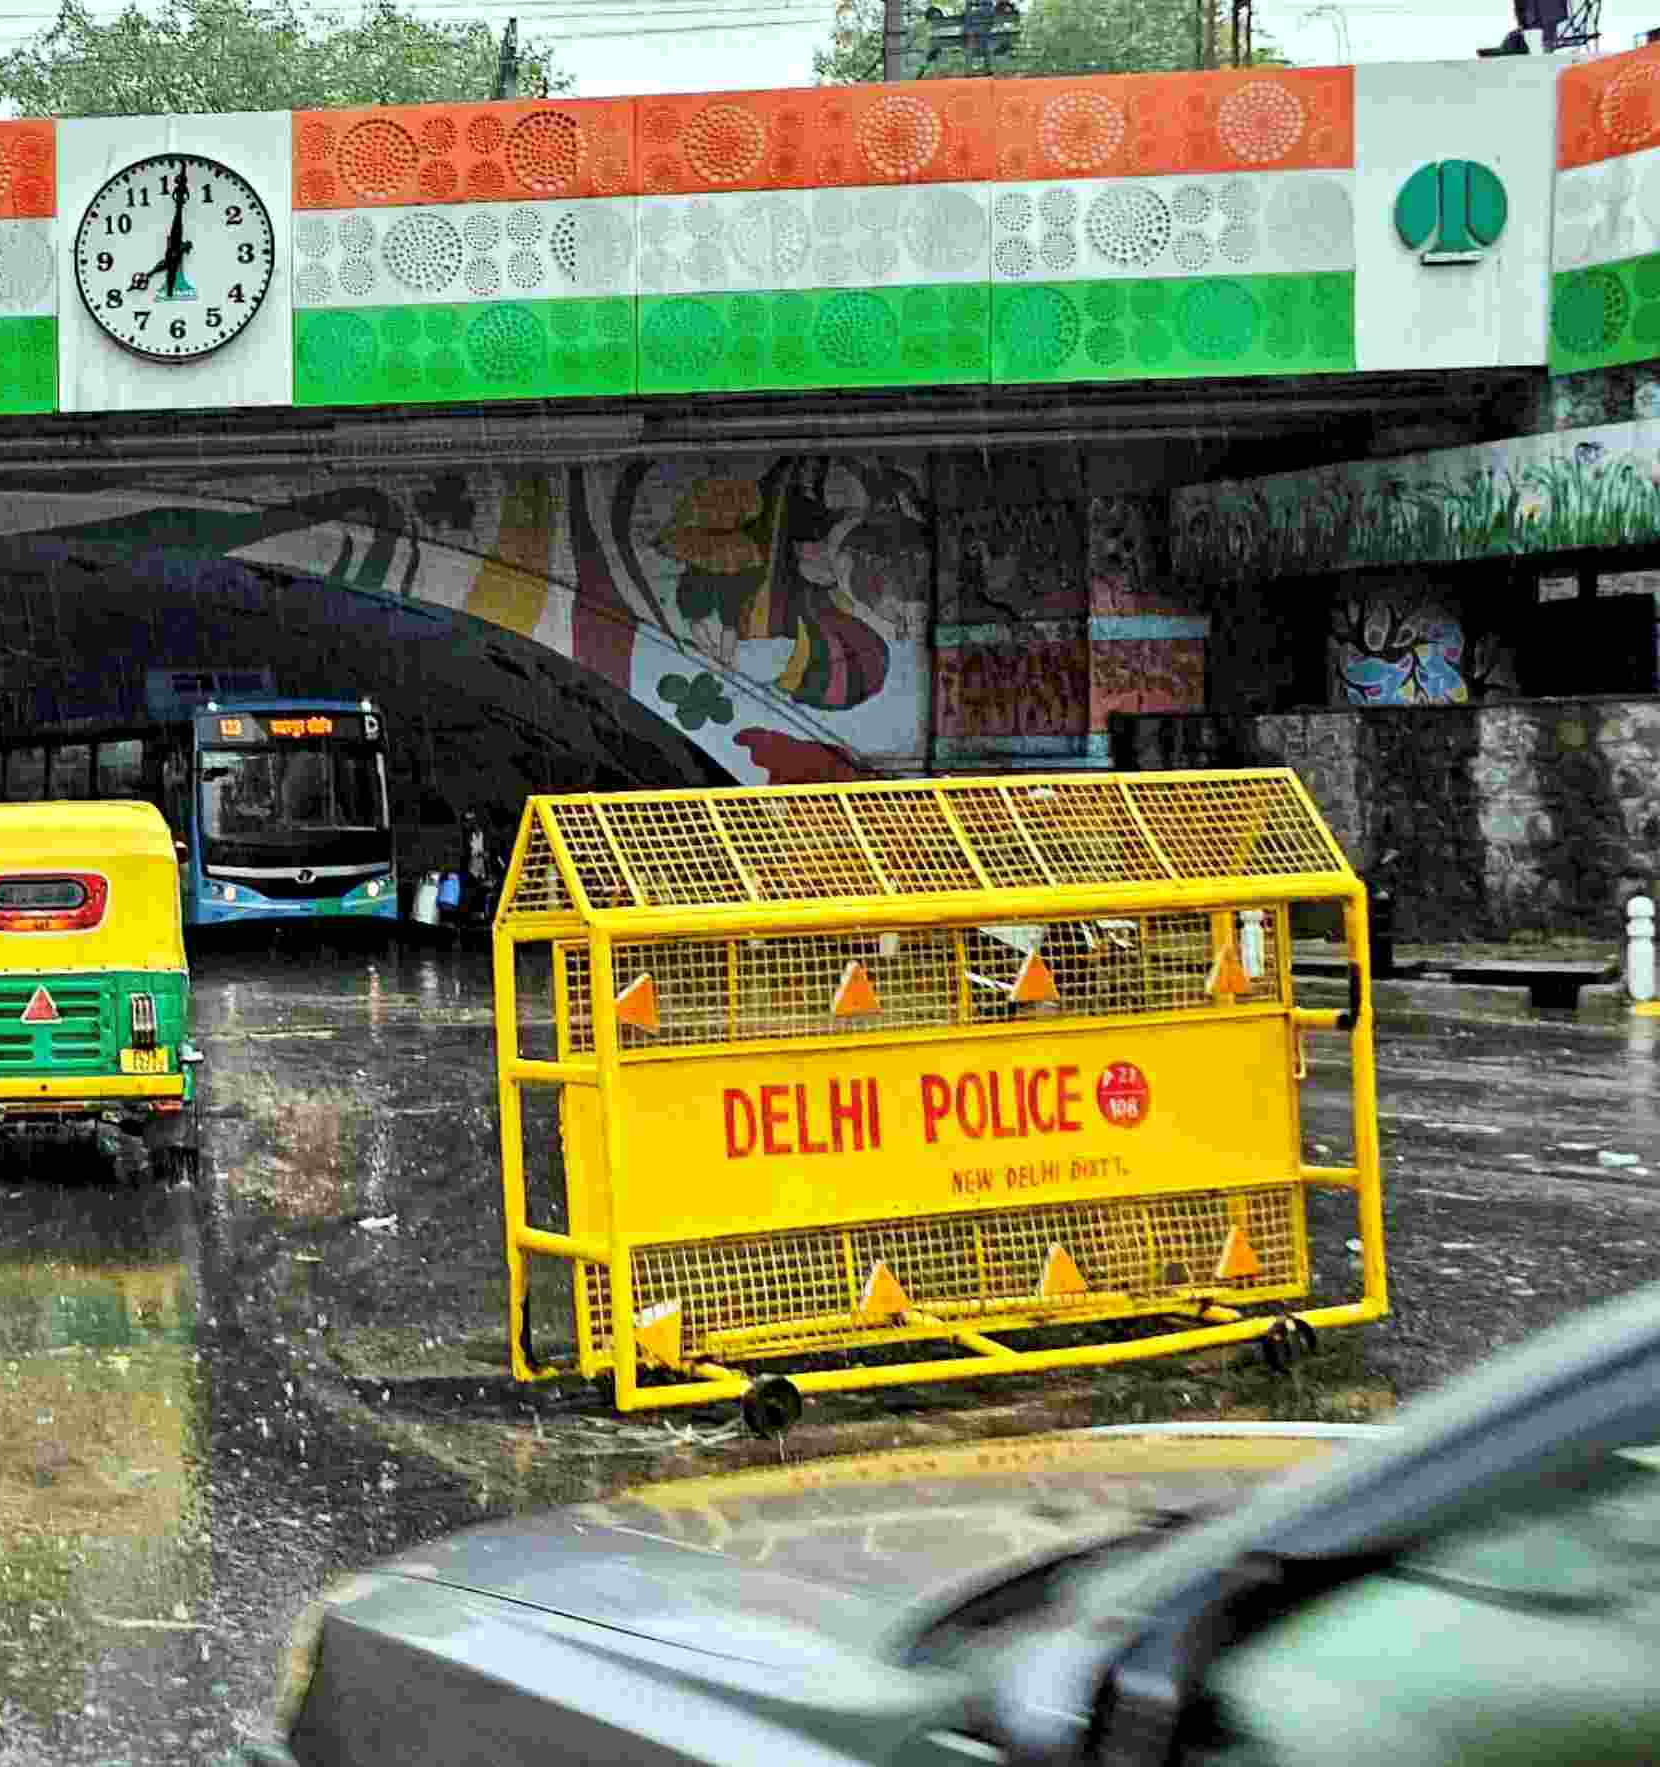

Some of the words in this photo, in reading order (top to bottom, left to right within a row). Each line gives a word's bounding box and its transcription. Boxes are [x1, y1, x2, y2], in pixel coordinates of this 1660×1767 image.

[127, 187, 150, 207] 11
[160, 175, 189, 202] 1
[202, 184, 213, 203] 1
[105, 214, 132, 234] 10
[225, 206, 243, 225] 2
[97, 252, 114, 271] 9
[237, 243, 254, 264] 3
[106, 289, 123, 309] 8
[228, 284, 244, 303] 4
[133, 311, 151, 331] 7
[206, 308, 222, 327] 5
[169, 320, 186, 339] 6
[723, 1076, 882, 1160] DELHI
[920, 1064, 1082, 1144] POLICE
[951, 1167, 993, 1196] NEW
[1005, 1159, 1060, 1192] DELHI
